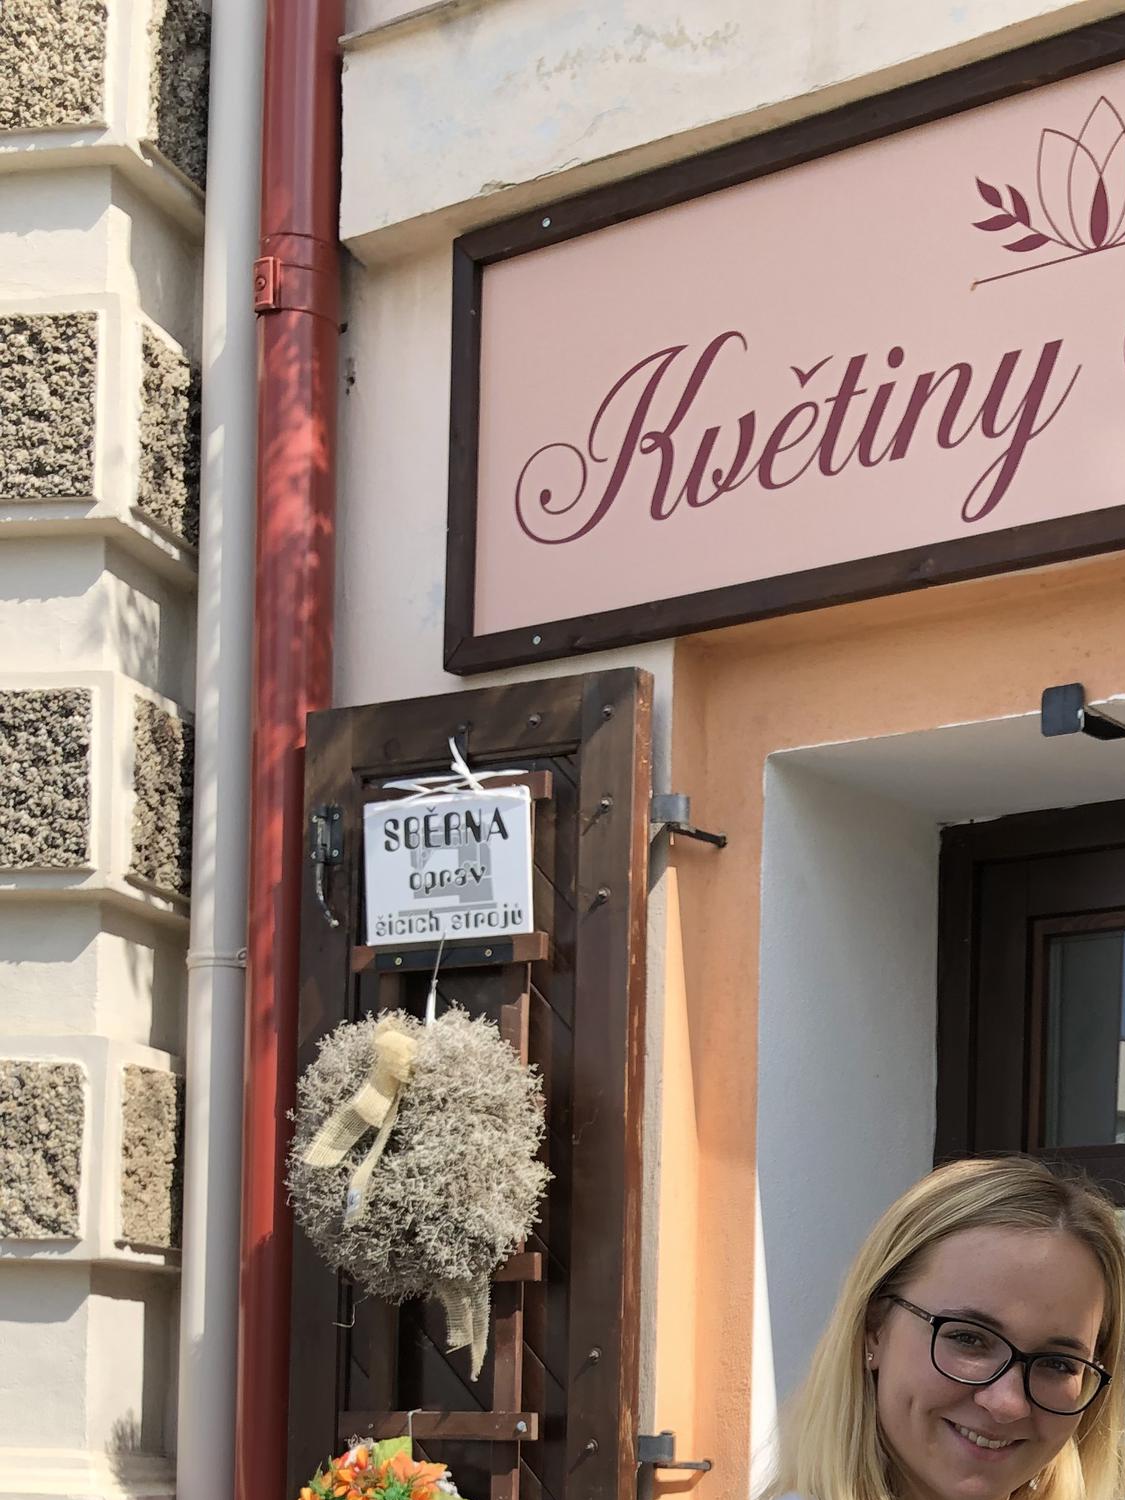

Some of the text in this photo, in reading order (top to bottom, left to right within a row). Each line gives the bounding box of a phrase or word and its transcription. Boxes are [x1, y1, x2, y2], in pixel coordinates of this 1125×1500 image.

[514, 330, 1082, 545] Květiny
[383, 805, 509, 852] SBĚRNA
[409, 866, 486, 895] oprav
